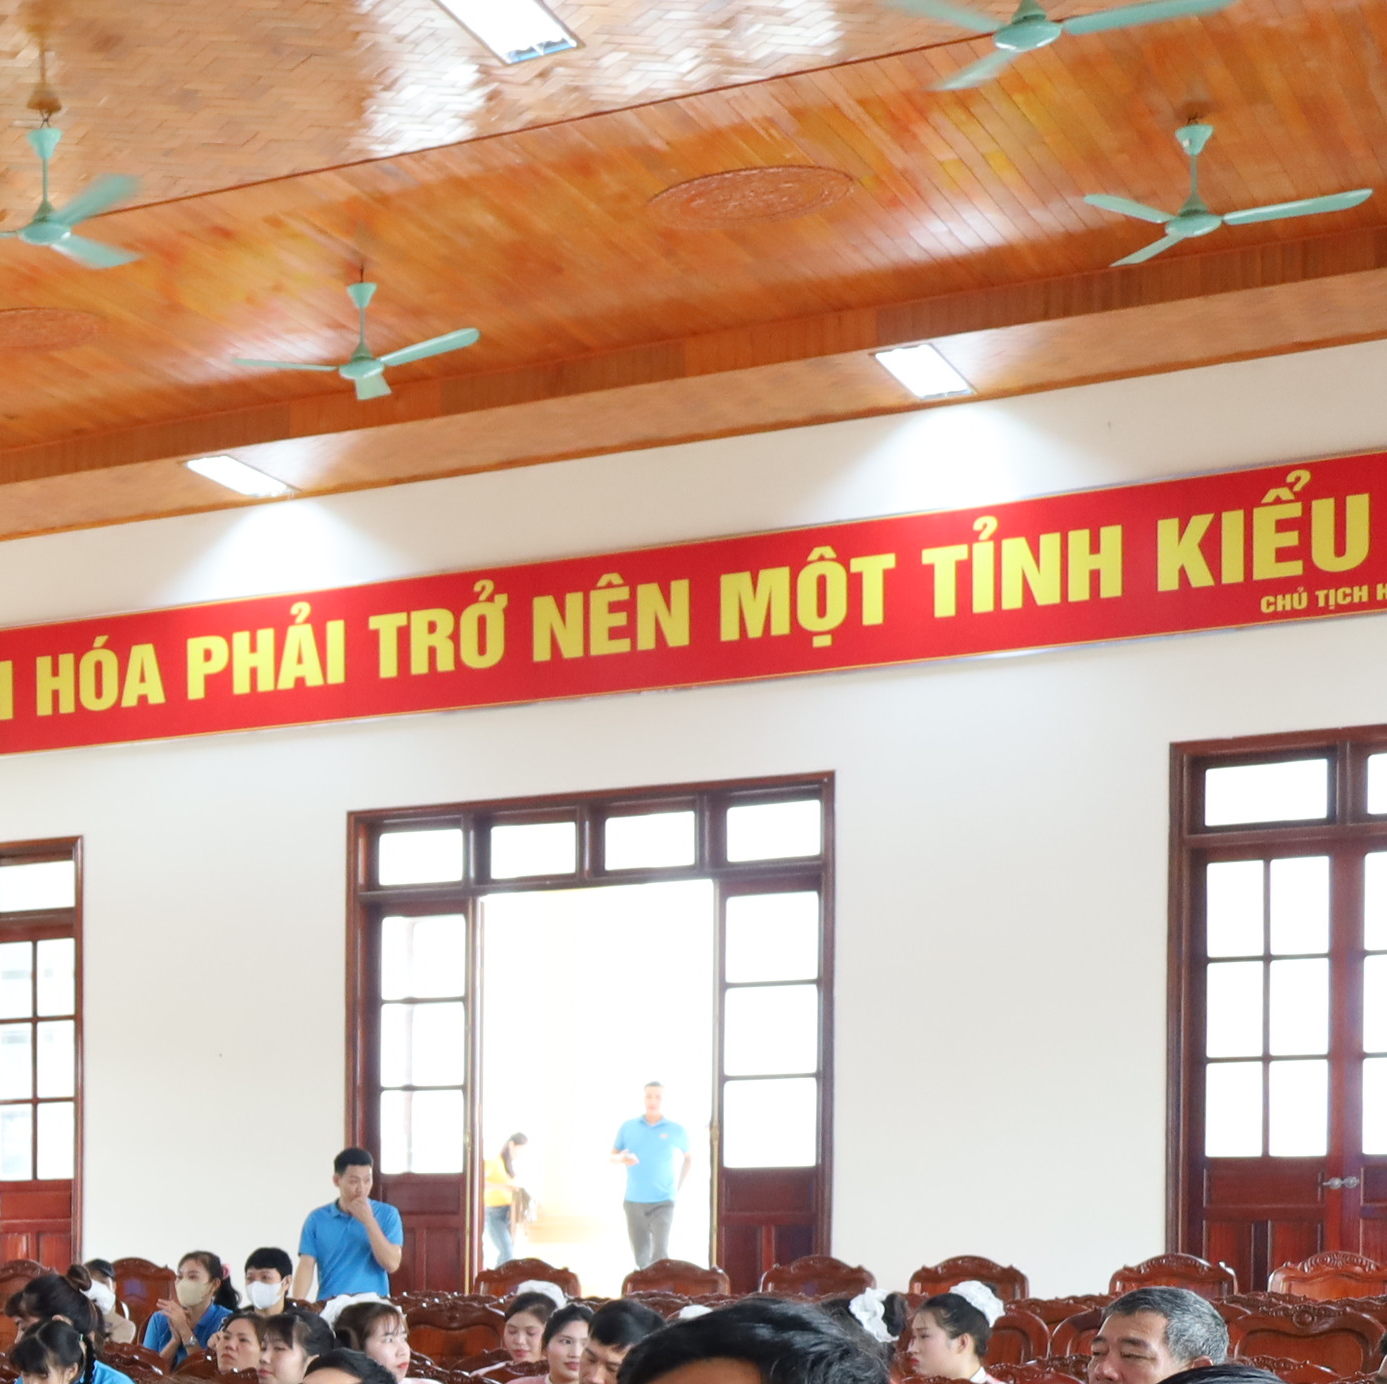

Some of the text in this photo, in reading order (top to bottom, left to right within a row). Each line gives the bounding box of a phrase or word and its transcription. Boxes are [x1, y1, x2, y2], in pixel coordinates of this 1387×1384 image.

[36, 635, 166, 716] HÓA
[186, 601, 346, 701] PHẢI
[368, 579, 509, 679] TRỞ
[533, 573, 690, 662] NÊN
[720, 545, 897, 648] MỘT
[922, 515, 1123, 618] TỈNH
[1157, 469, 1370, 592] KIỂU
[1260, 586, 1308, 614] CHỦ
[1315, 585, 1369, 610] TỊCH
